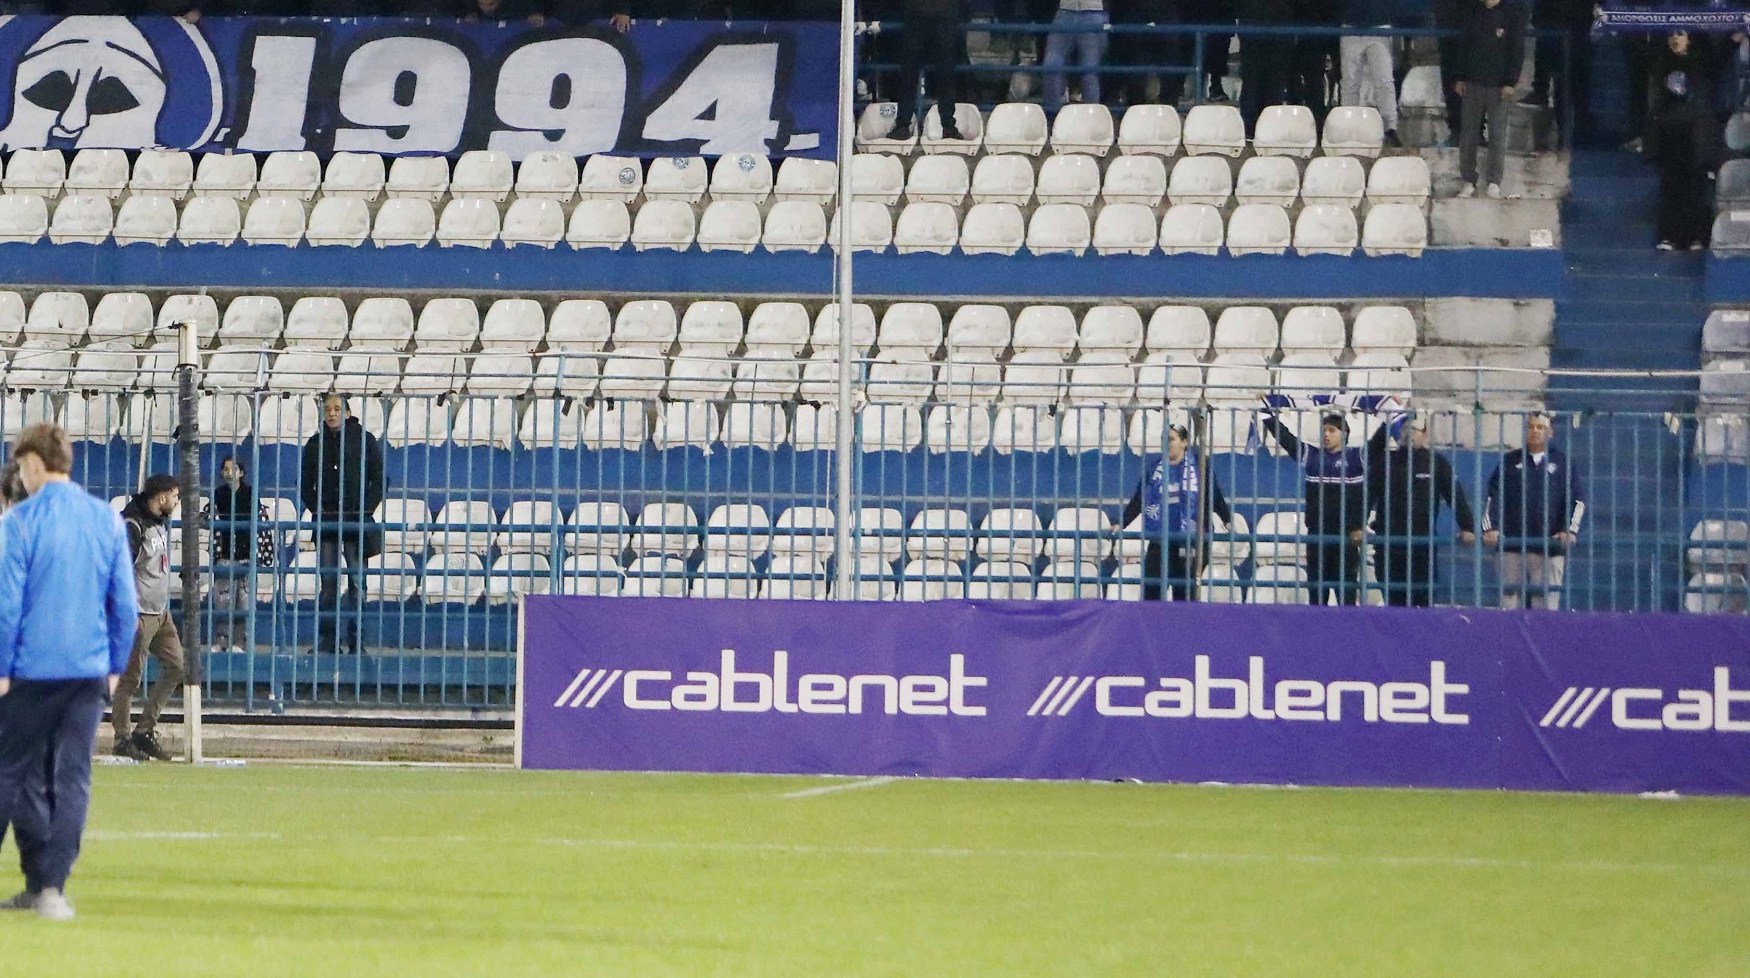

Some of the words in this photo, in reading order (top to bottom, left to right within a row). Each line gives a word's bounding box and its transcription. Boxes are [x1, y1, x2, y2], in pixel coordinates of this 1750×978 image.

[247, 34, 781, 157] 1994
[623, 648, 987, 717] cablenet
[1095, 654, 1470, 725] cablenet
